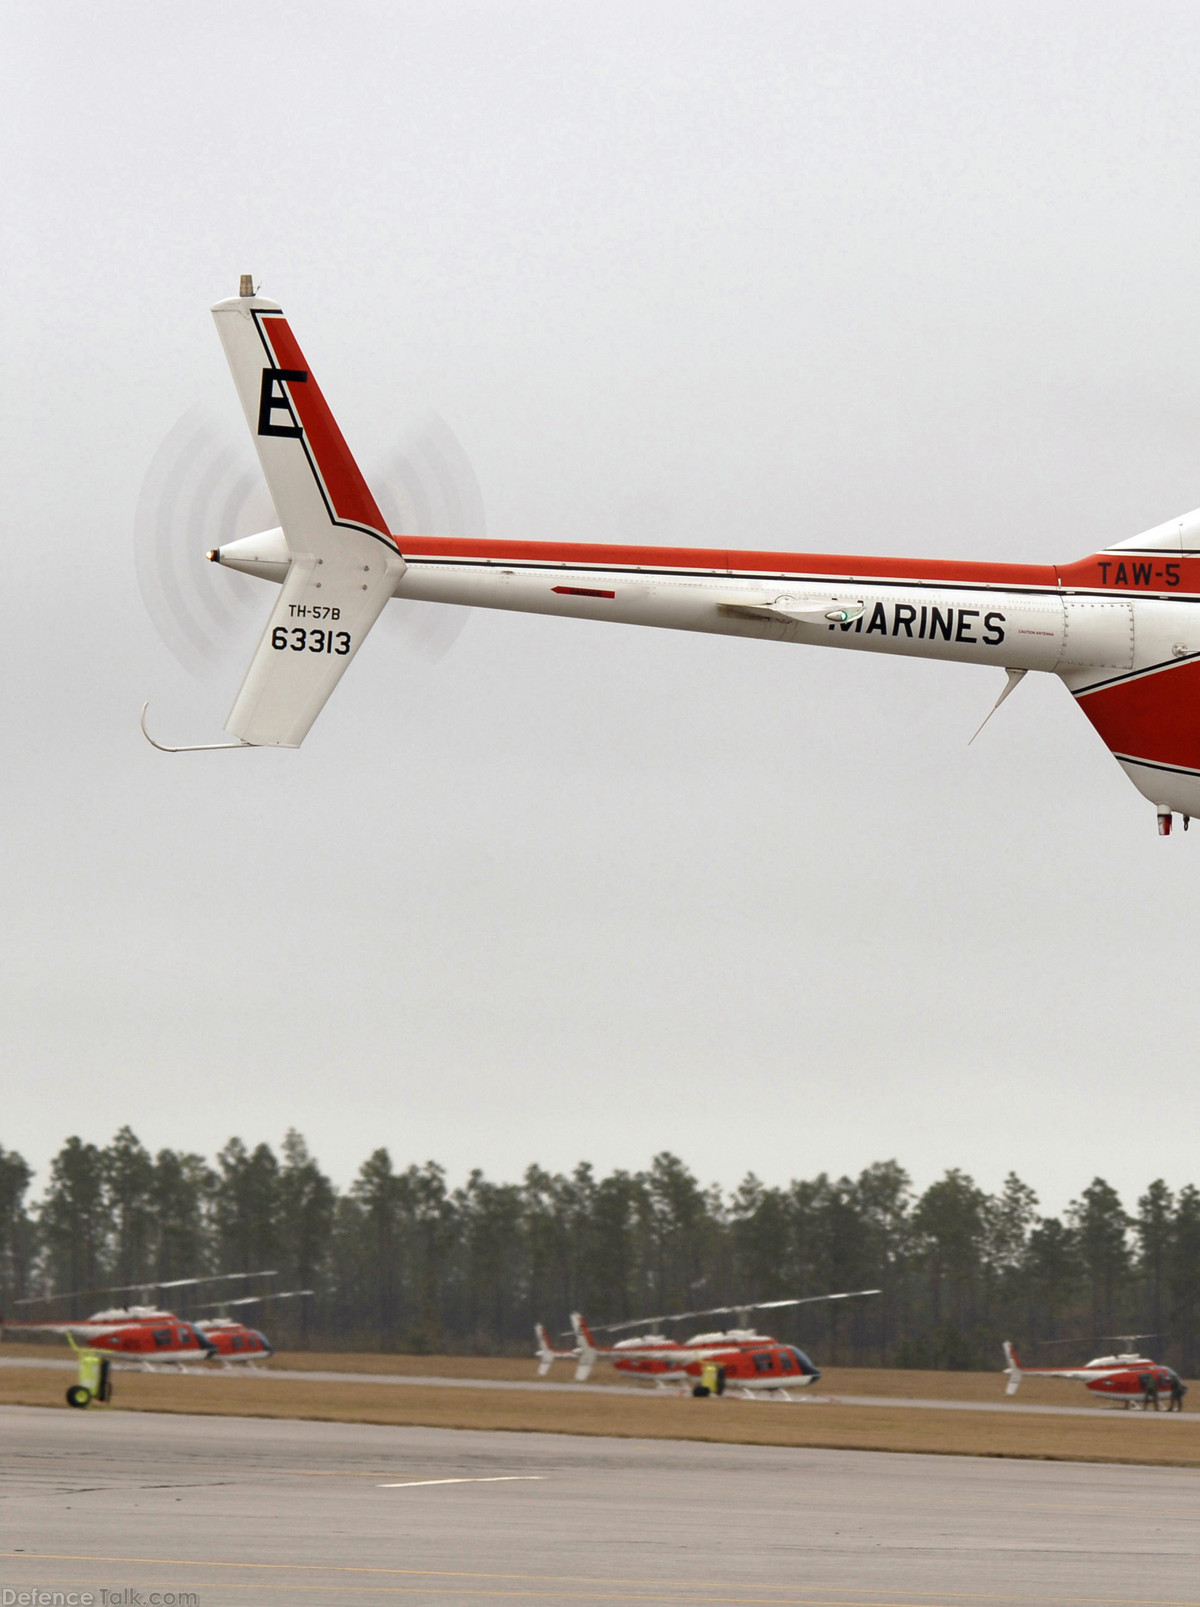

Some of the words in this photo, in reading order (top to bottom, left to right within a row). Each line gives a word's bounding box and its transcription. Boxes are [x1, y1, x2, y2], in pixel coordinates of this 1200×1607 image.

[258, 367, 308, 438] E
[1098, 562, 1180, 586] TAW-5
[289, 604, 341, 621] TH-57B
[271, 626, 351, 655] 63313
